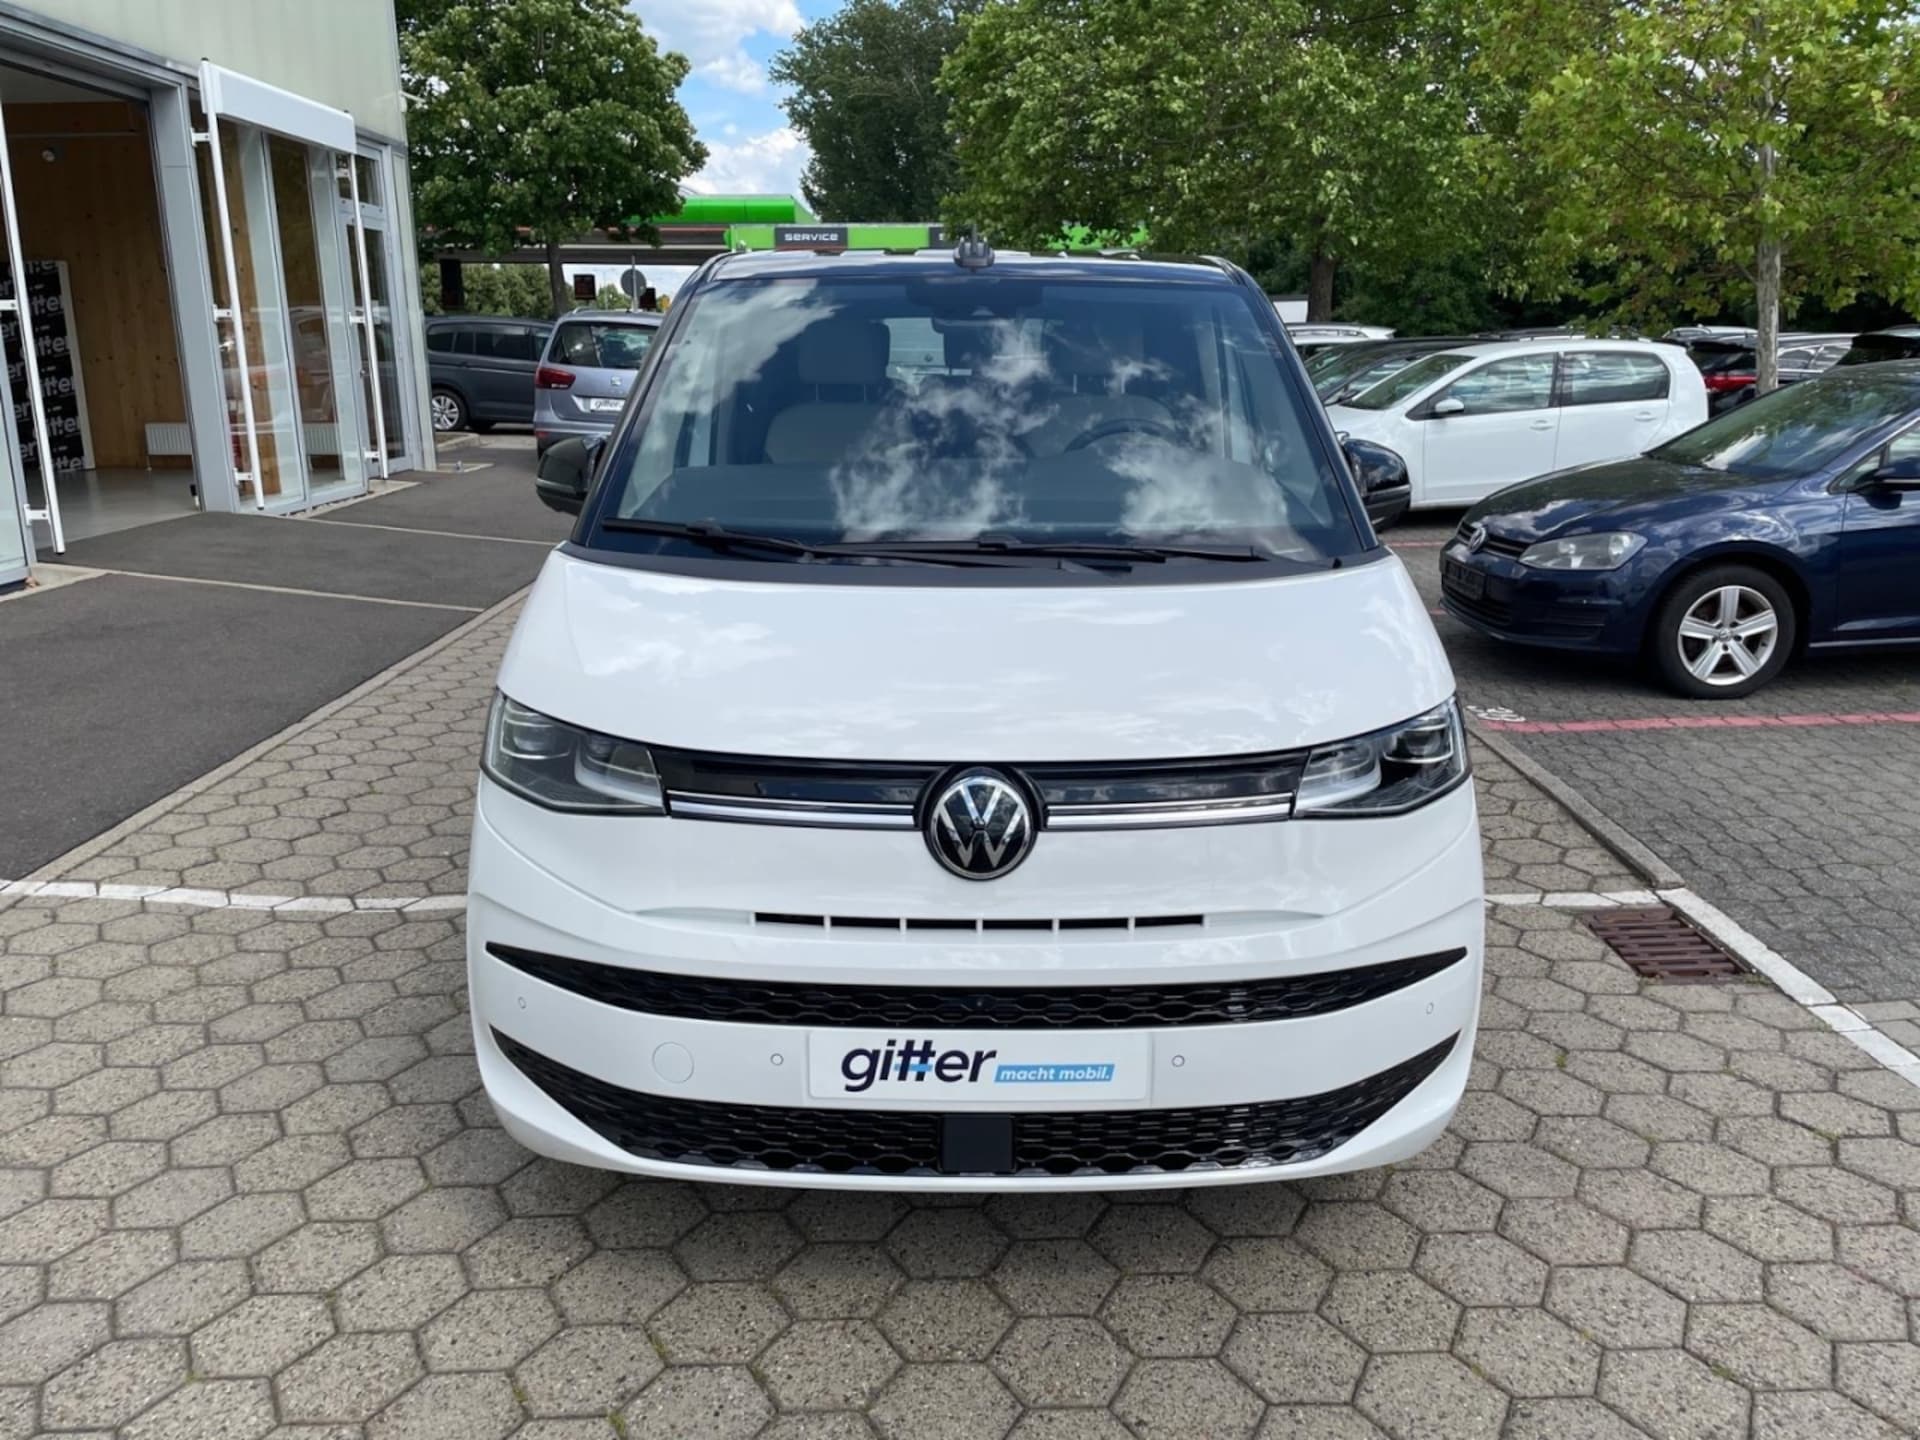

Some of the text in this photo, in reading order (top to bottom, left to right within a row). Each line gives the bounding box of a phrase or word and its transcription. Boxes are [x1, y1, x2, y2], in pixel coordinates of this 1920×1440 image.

[785, 232, 839, 241] SERVICE
[841, 1039, 1110, 1092] gitter macht mobil.
